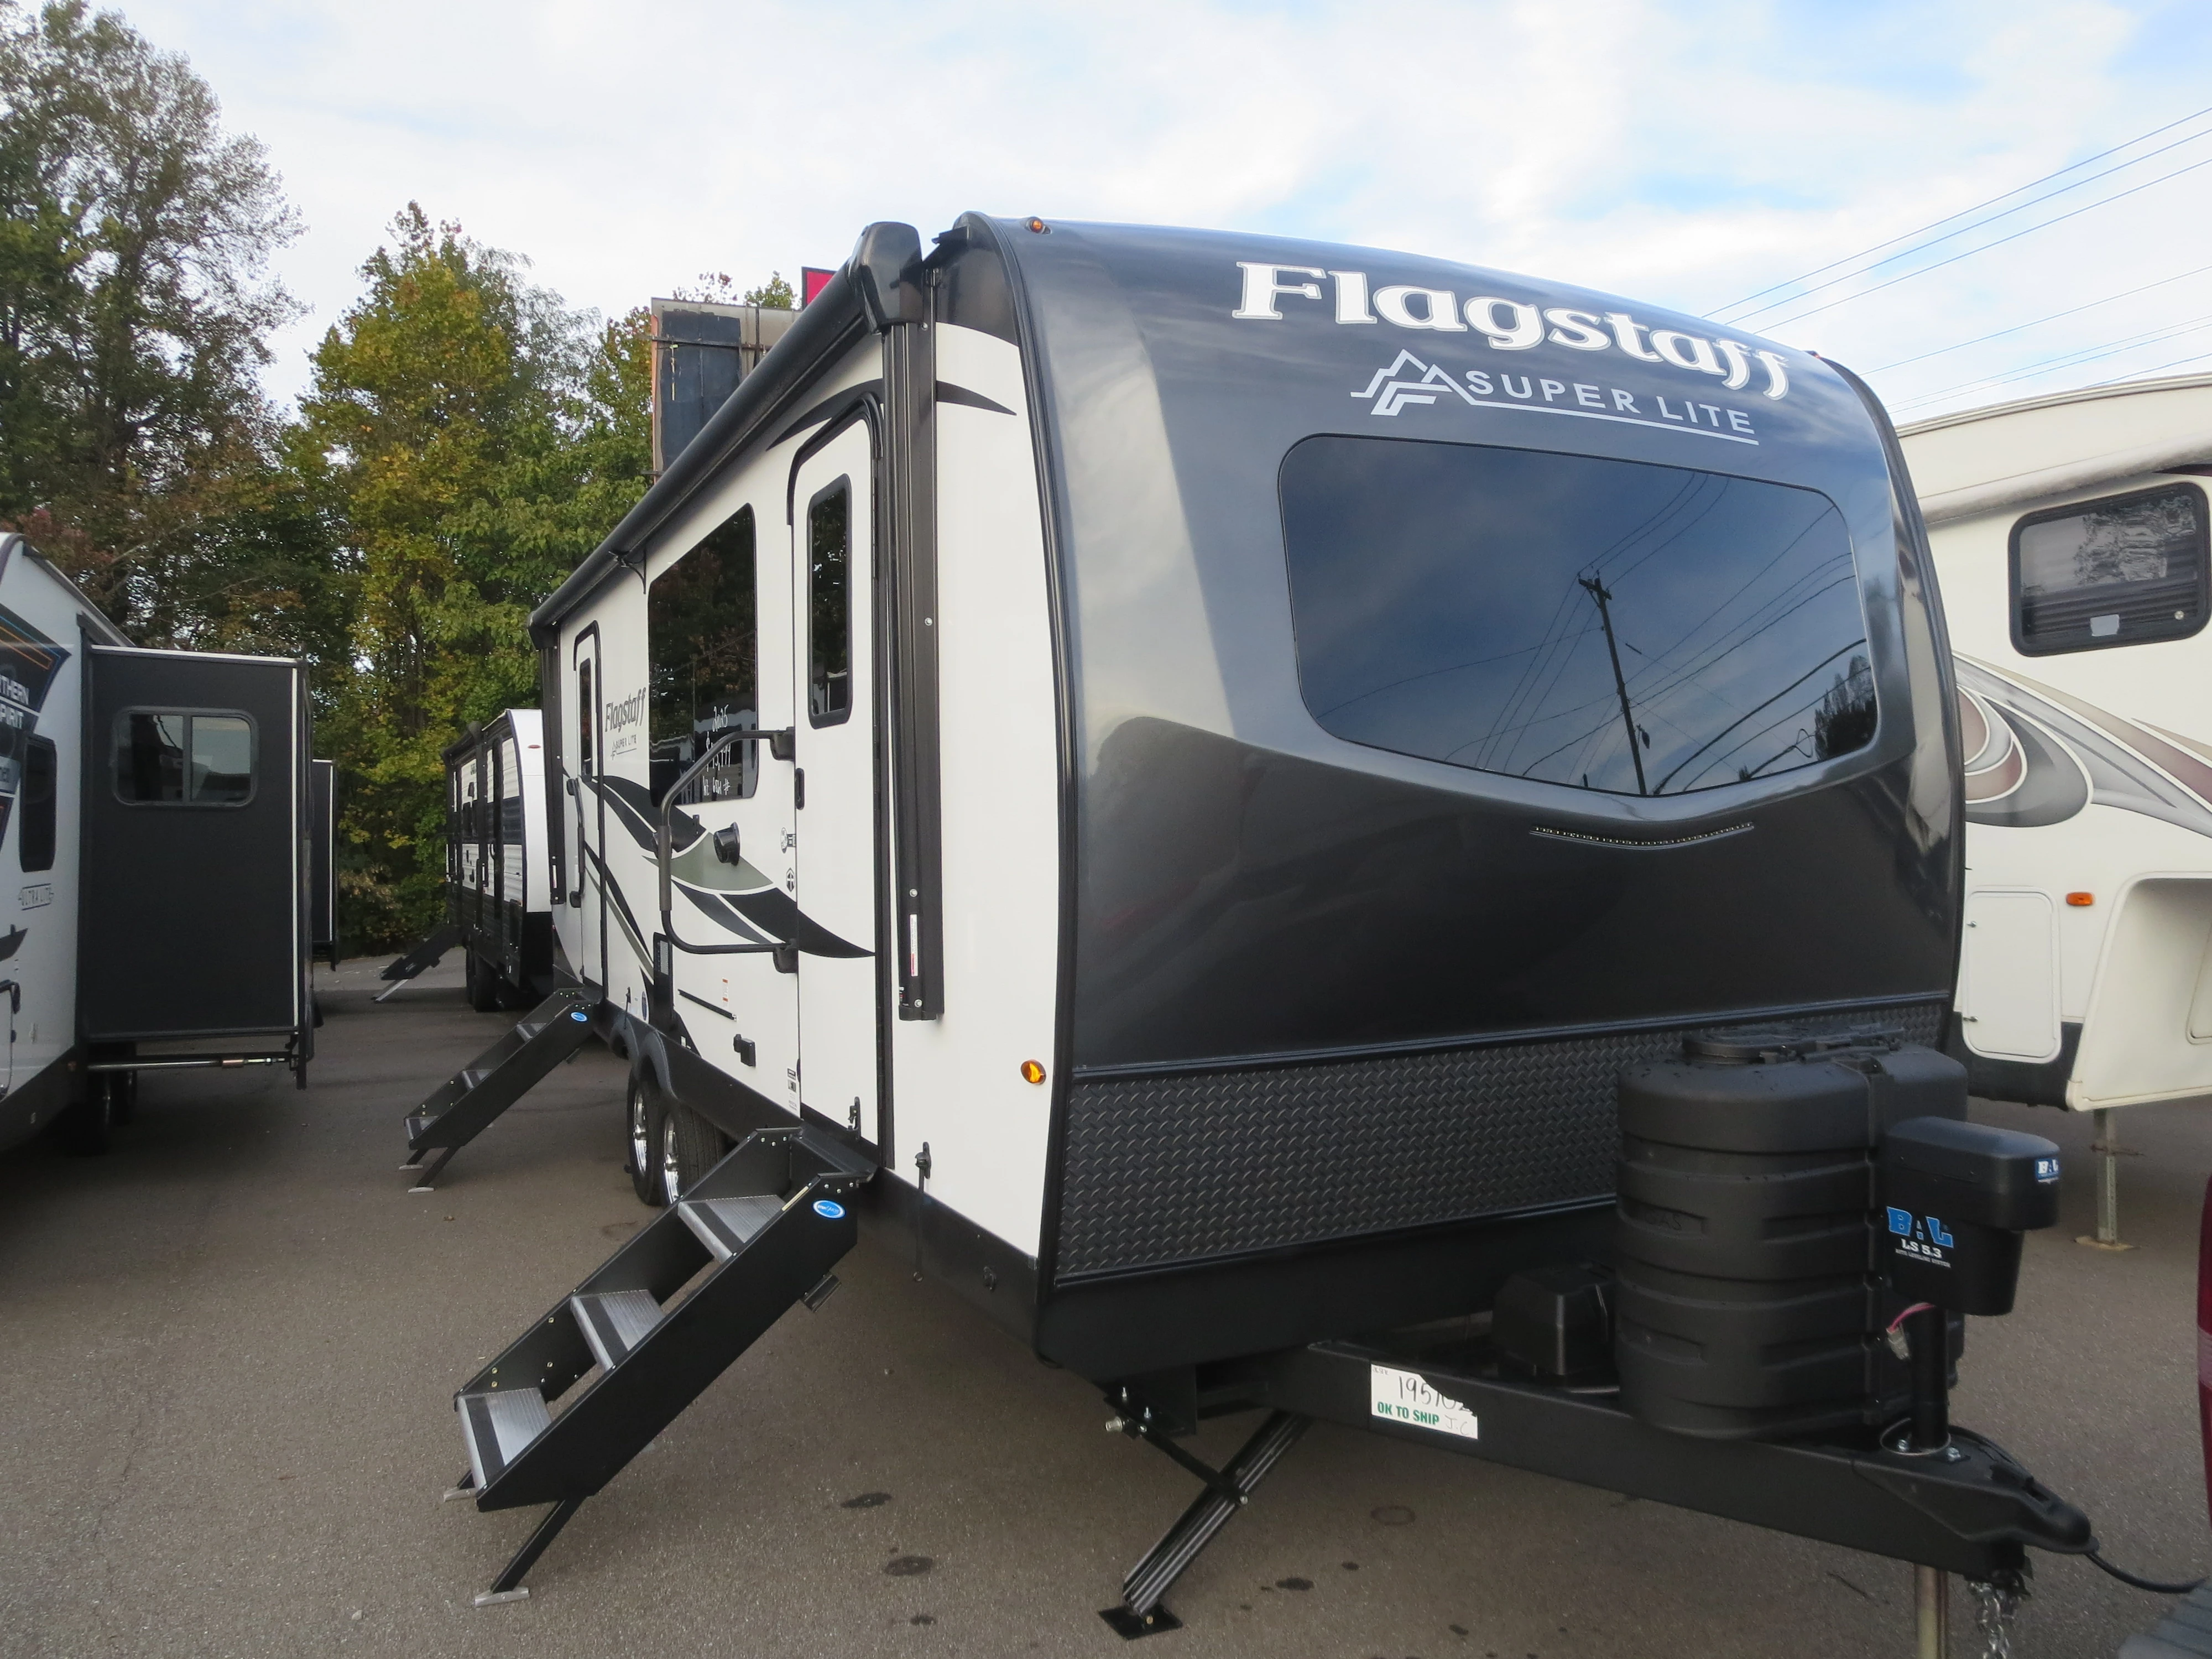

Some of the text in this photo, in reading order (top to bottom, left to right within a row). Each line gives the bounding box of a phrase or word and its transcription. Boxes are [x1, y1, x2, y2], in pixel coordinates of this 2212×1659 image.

[1232, 260, 1789, 400] Flagstaff
[1467, 369, 1755, 434] SUPER LITE
[604, 687, 646, 733] Flagstaff
[1901, 1238, 1943, 1259] LS 5.3
[1378, 1401, 1440, 1426] OK TO SHIP
